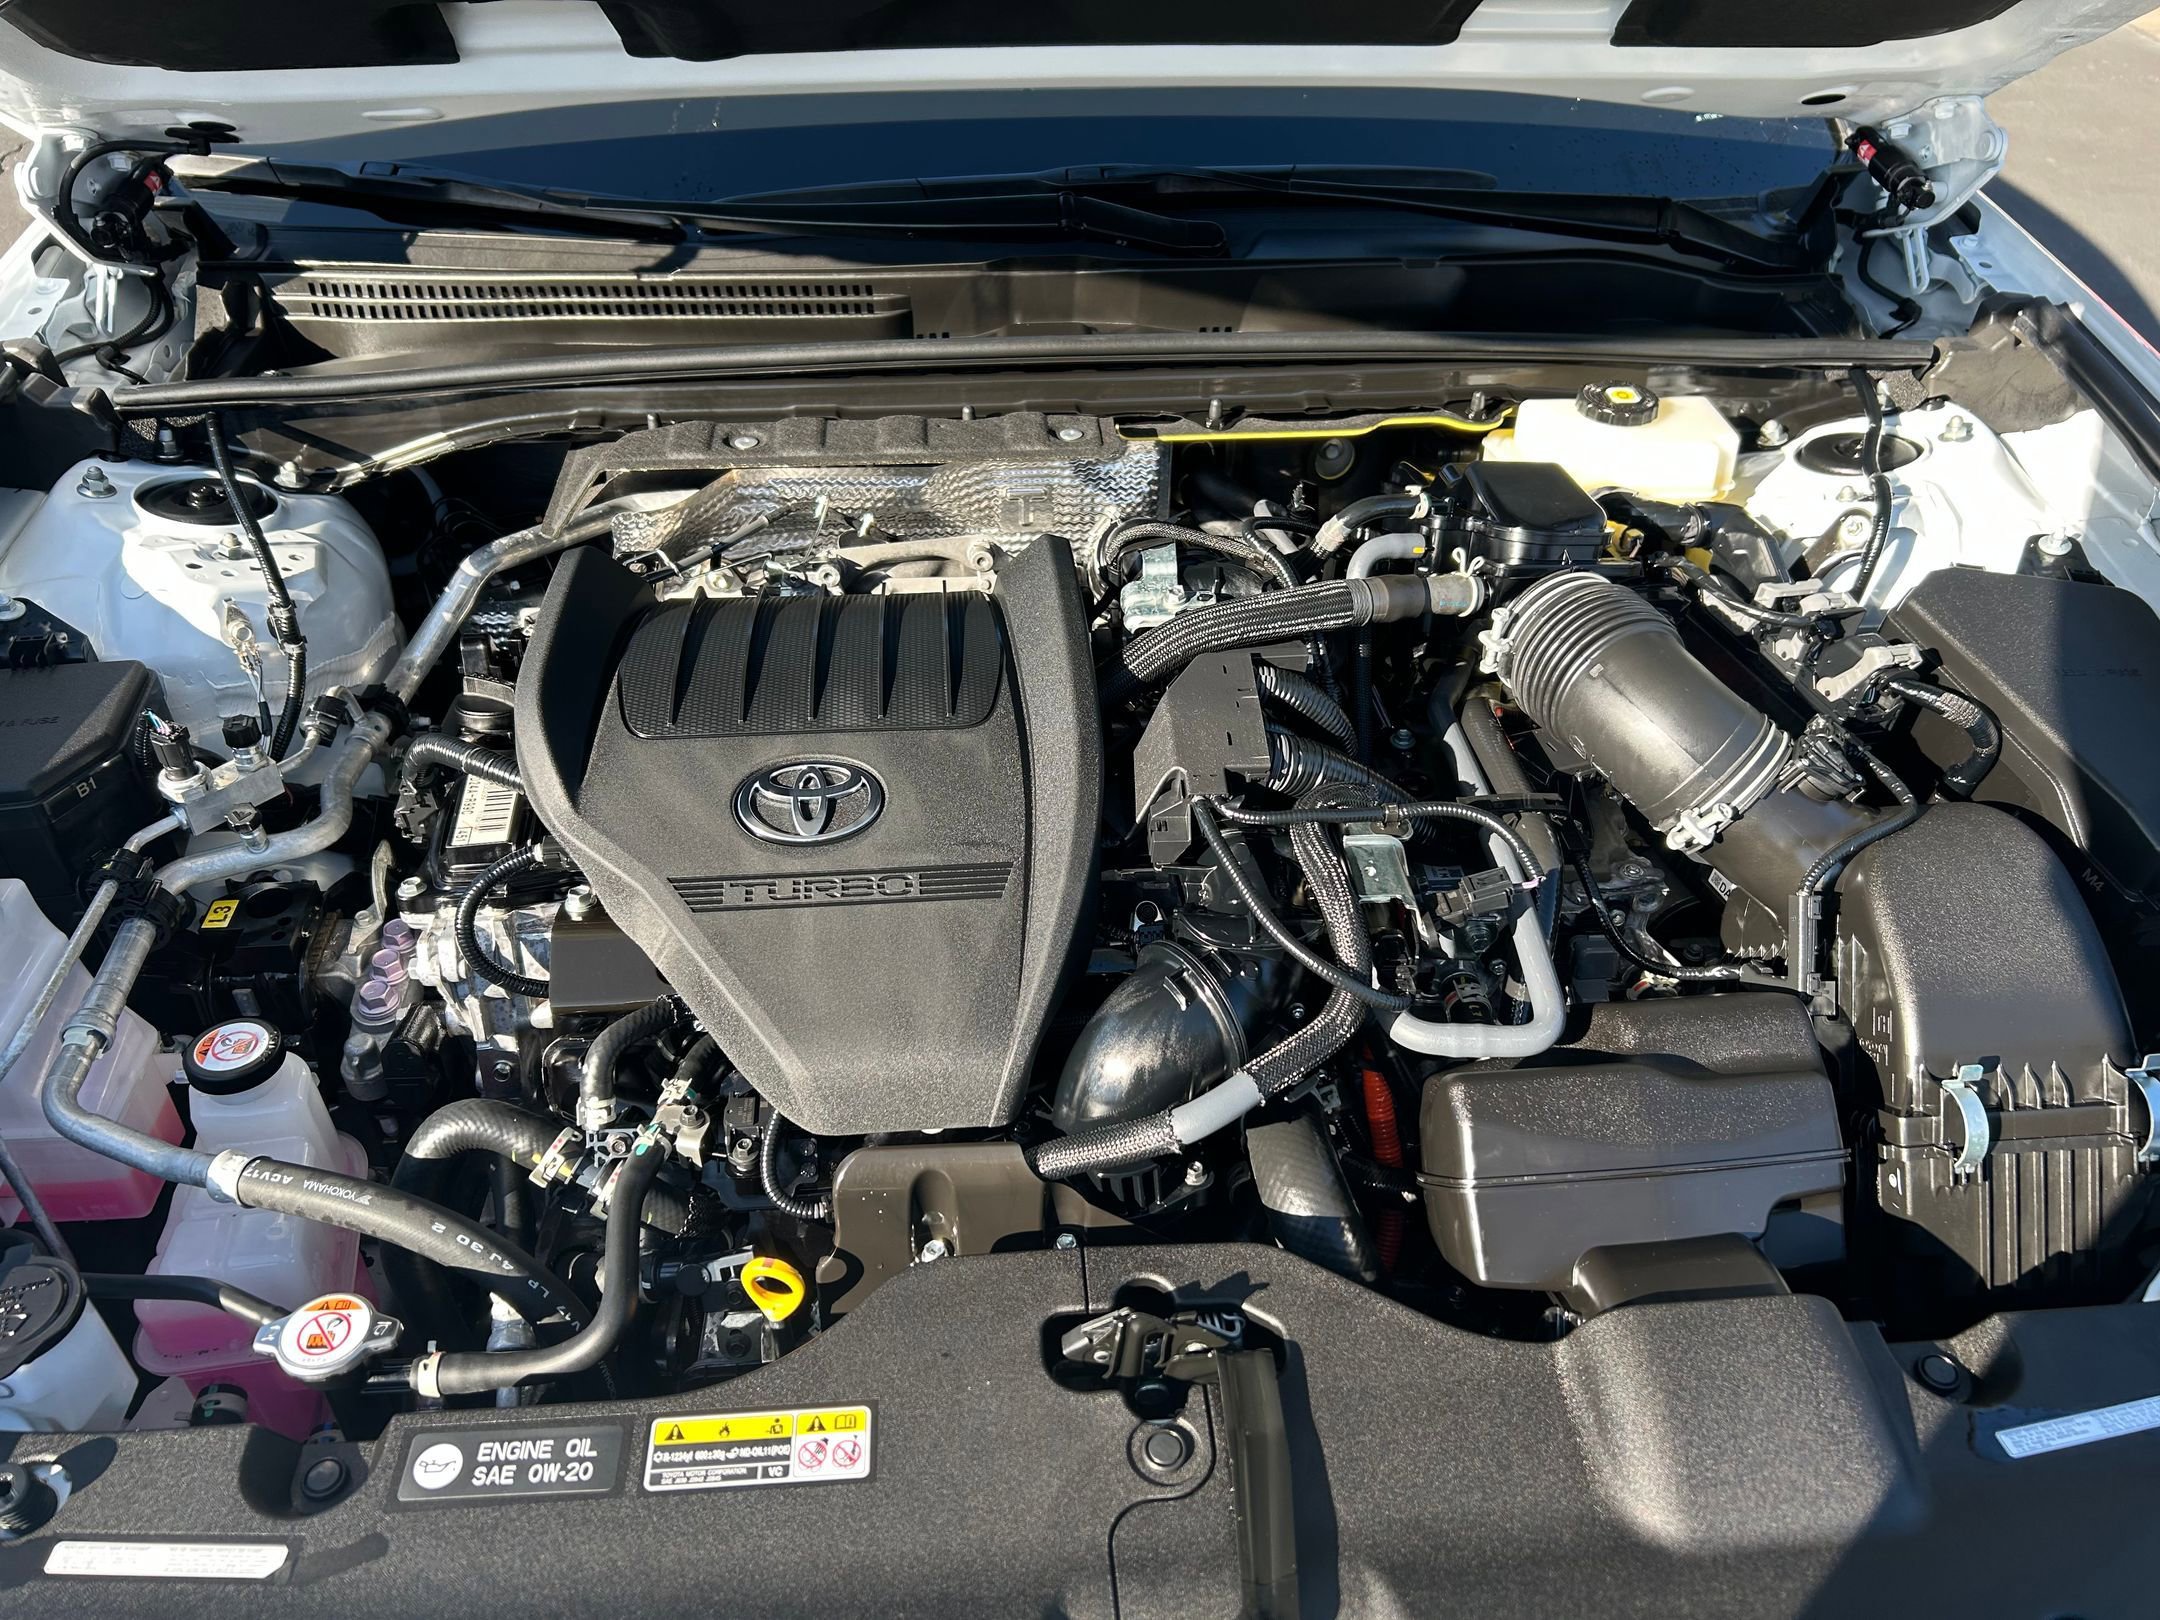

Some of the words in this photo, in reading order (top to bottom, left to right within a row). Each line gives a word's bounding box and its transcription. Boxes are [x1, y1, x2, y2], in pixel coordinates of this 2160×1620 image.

[76, 776, 97, 798] B1
[729, 874, 914, 902] TURBO
[2082, 868, 2104, 892] M4
[208, 906, 231, 923] L3
[243, 1167, 293, 1184] ACV17
[303, 1179, 356, 1200] YOKOHAMA
[476, 1440, 554, 1462] ENGINE
[565, 1438, 598, 1458] OIL
[471, 1464, 517, 1486] SAE
[528, 1461, 594, 1484] 0W-20
[662, 1471, 684, 1479] TOYOTA
[685, 1469, 706, 1478] MOTOR
[707, 1467, 748, 1476] CORPORATION
[768, 1466, 783, 1477] VC
